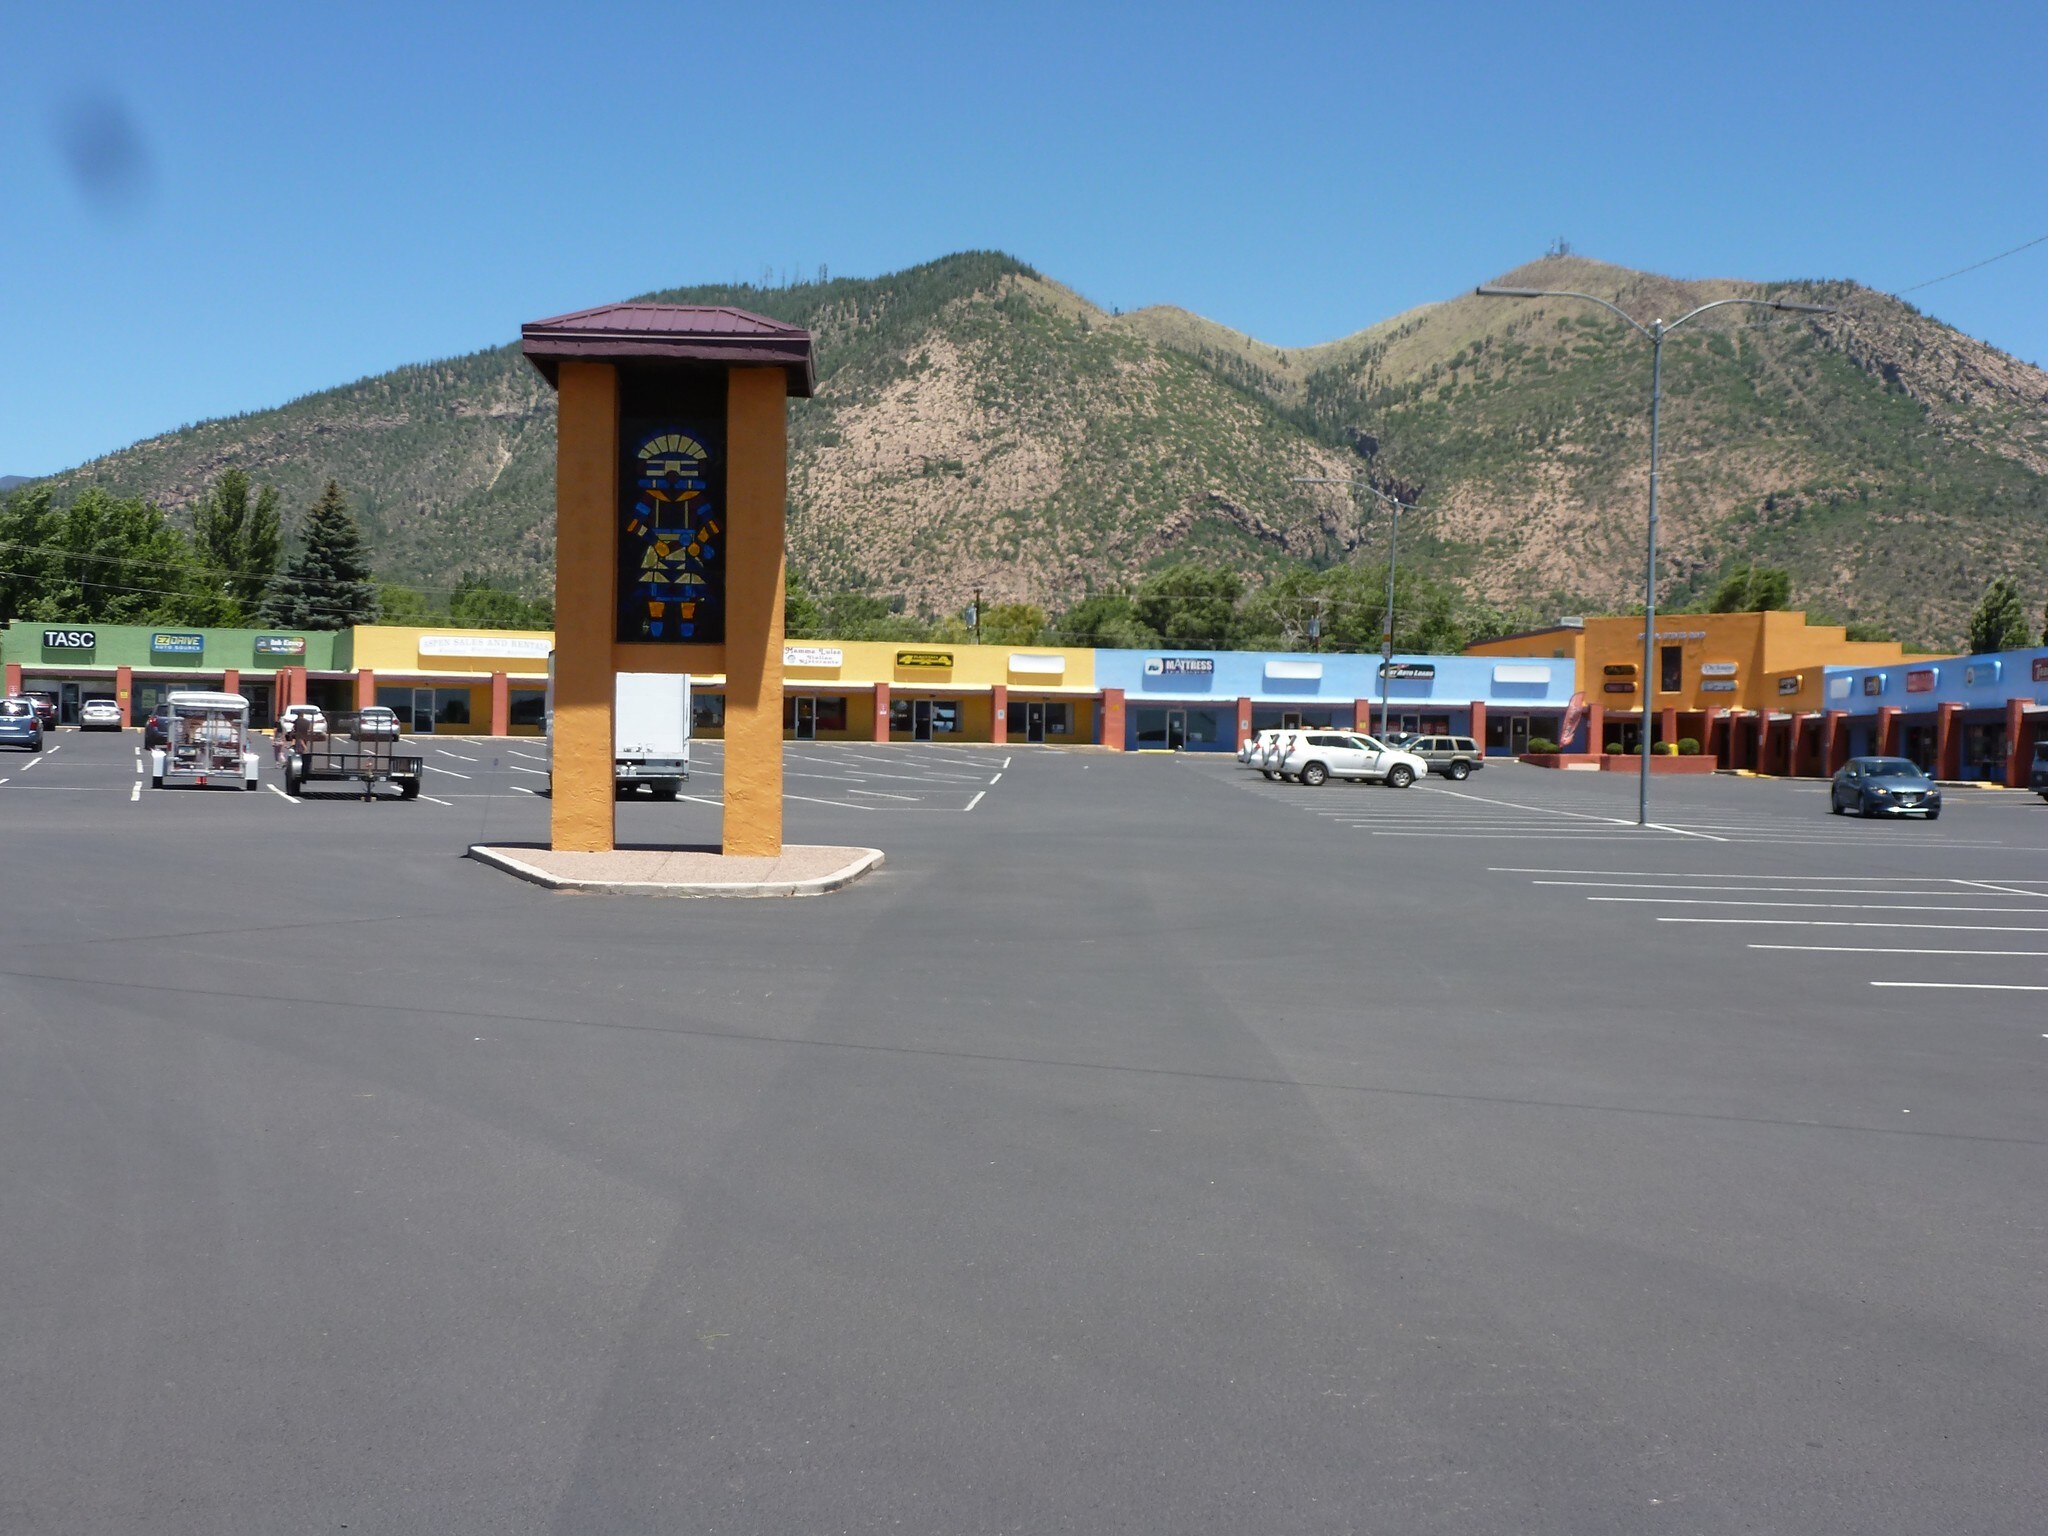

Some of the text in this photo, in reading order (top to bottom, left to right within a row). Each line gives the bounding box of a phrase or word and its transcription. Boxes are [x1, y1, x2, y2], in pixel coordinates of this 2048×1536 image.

[45, 631, 95, 647] TASC
[156, 635, 200, 645] EZ DRIVE
[453, 639, 484, 647] SALES
[487, 639, 508, 647] AND
[511, 640, 549, 650] RENTALS
[1166, 659, 1213, 670] MATTRESS
